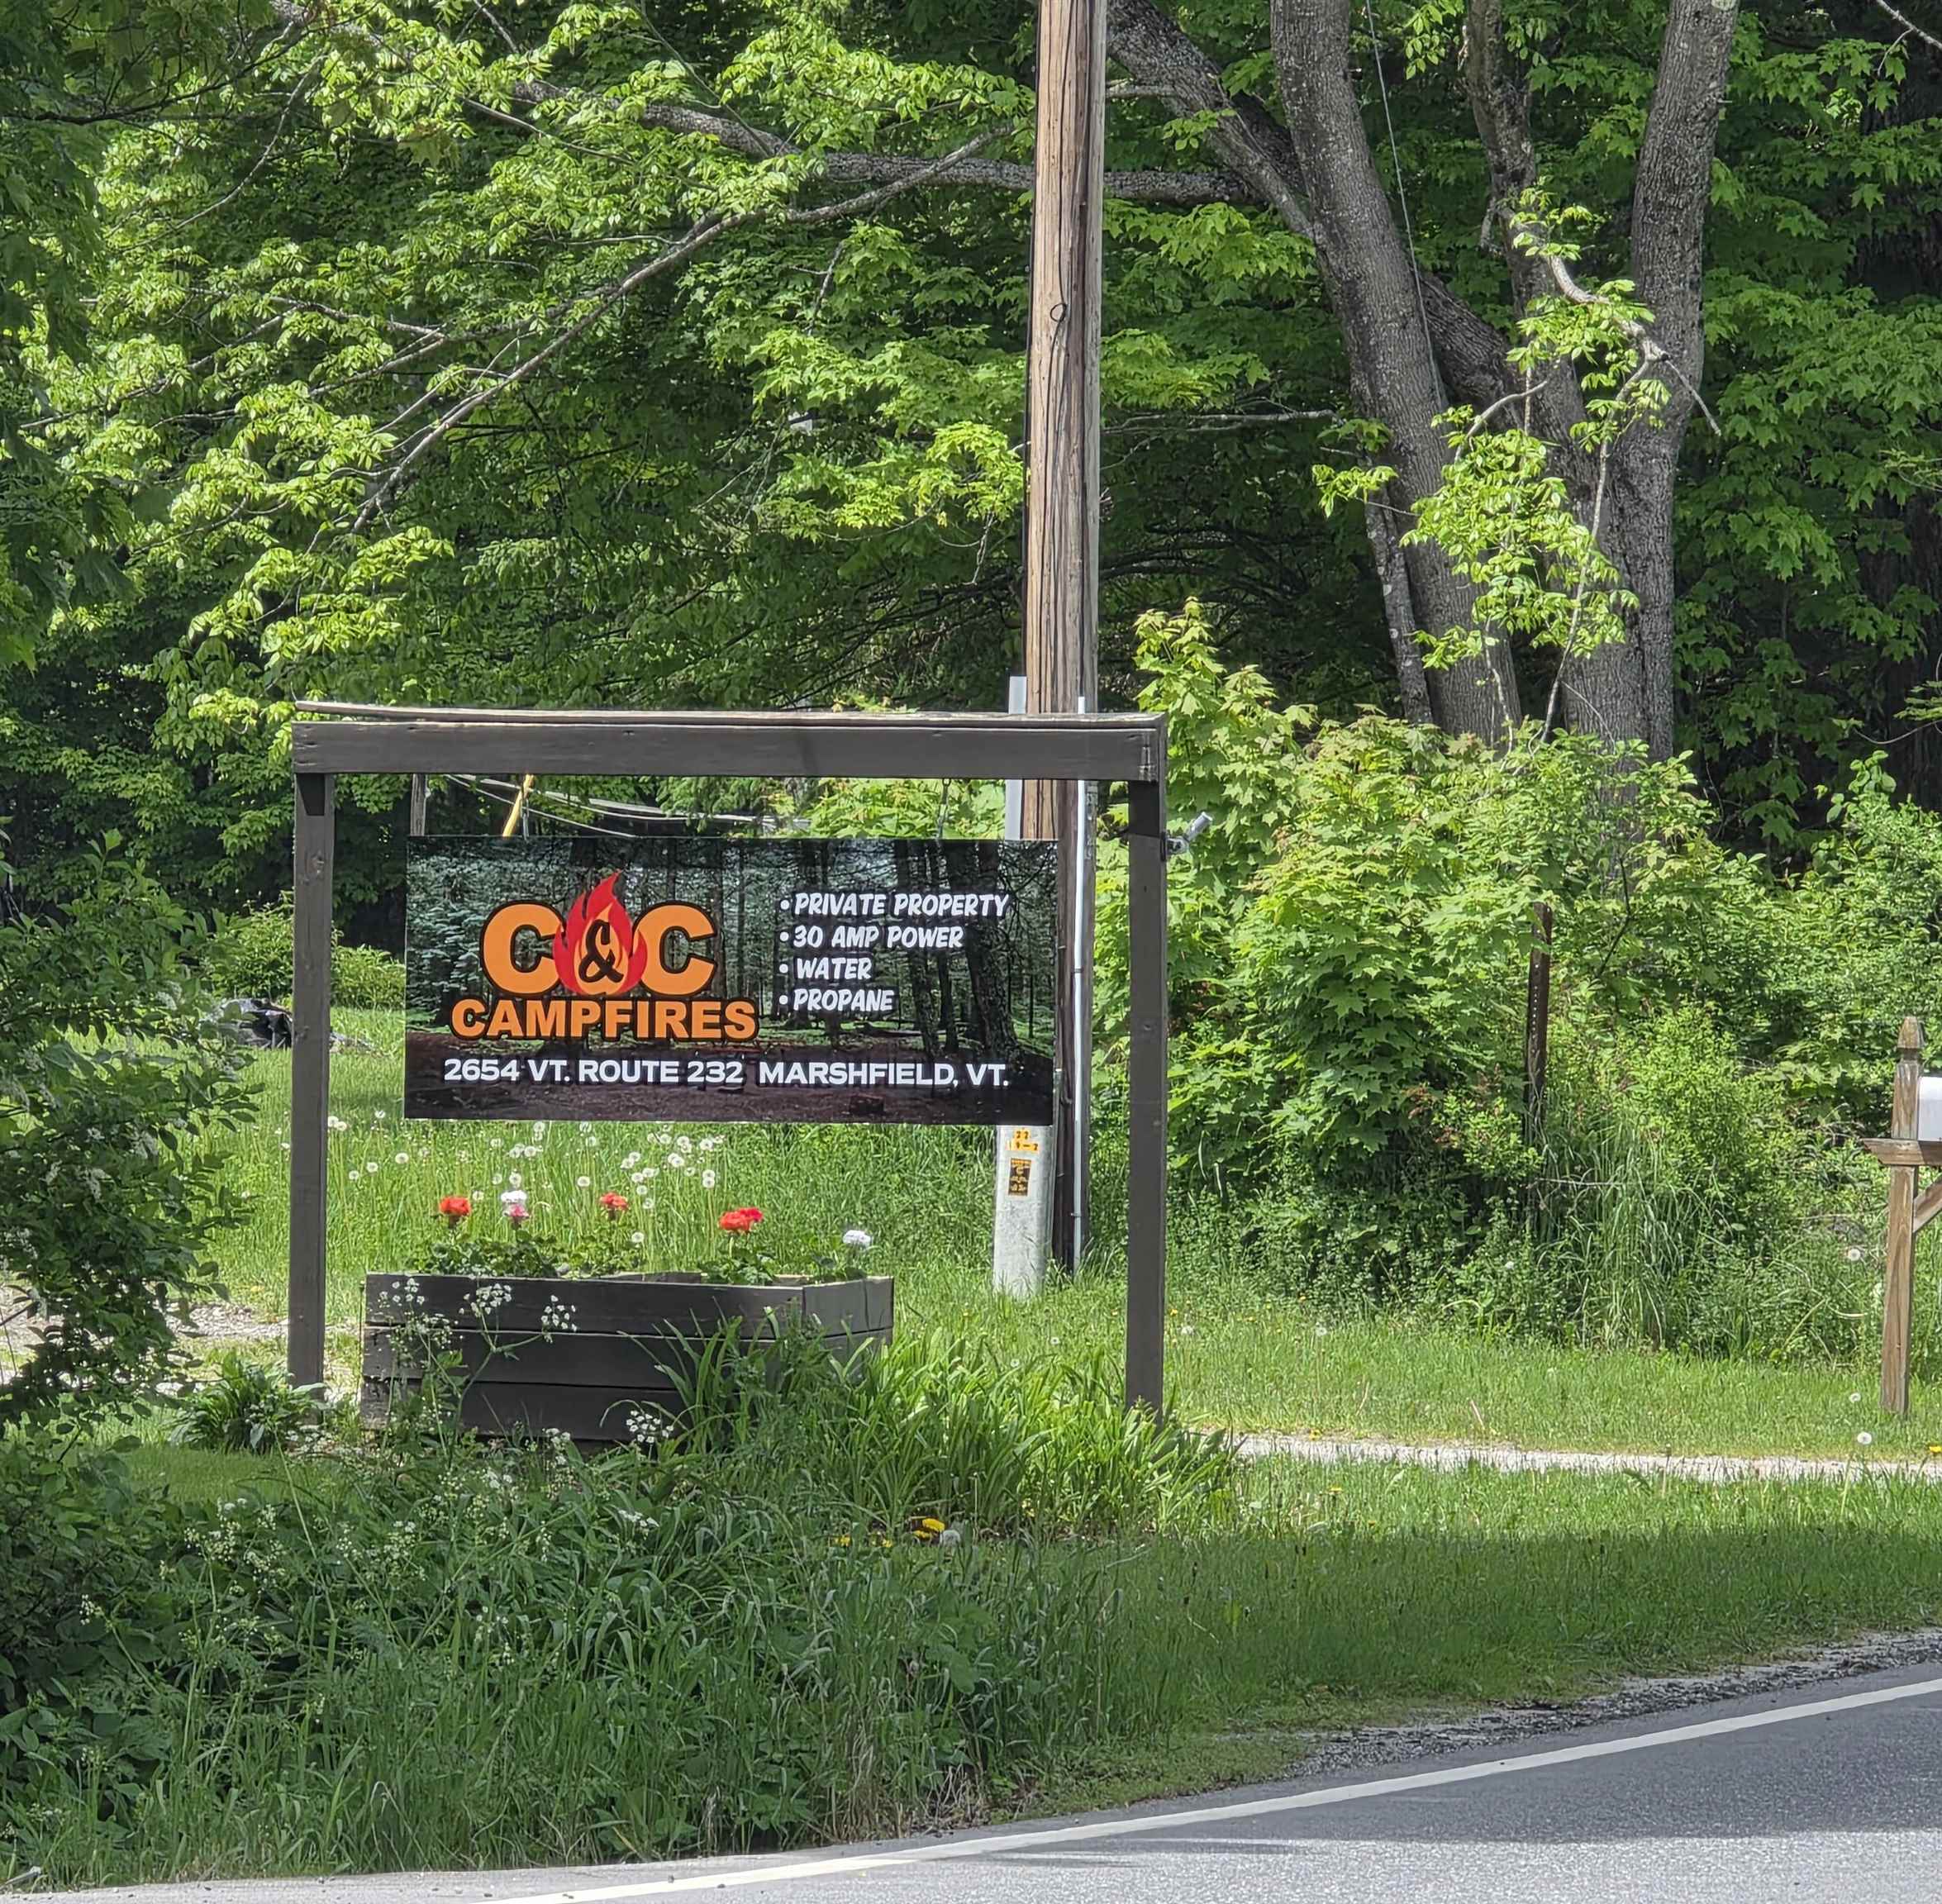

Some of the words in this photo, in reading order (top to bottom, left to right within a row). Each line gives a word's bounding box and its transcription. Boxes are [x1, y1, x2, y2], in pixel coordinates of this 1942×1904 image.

[794, 892, 886, 916] PRIVATE
[893, 893, 1010, 916] PROPERTY
[793, 926, 823, 948] 30
[831, 926, 879, 948] AMP
[887, 926, 964, 949] POWER
[797, 958, 873, 979] WATER
[793, 988, 895, 1011] PROPANE
[450, 997, 758, 1040] CAMPFIRES
[444, 1059, 520, 1082] 2654
[529, 1060, 569, 1082] VT.
[578, 1060, 679, 1083] ROUTE
[687, 1061, 744, 1083] 232
[759, 1062, 959, 1087] MARSHFIELD,
[966, 1063, 1009, 1086] VT.
